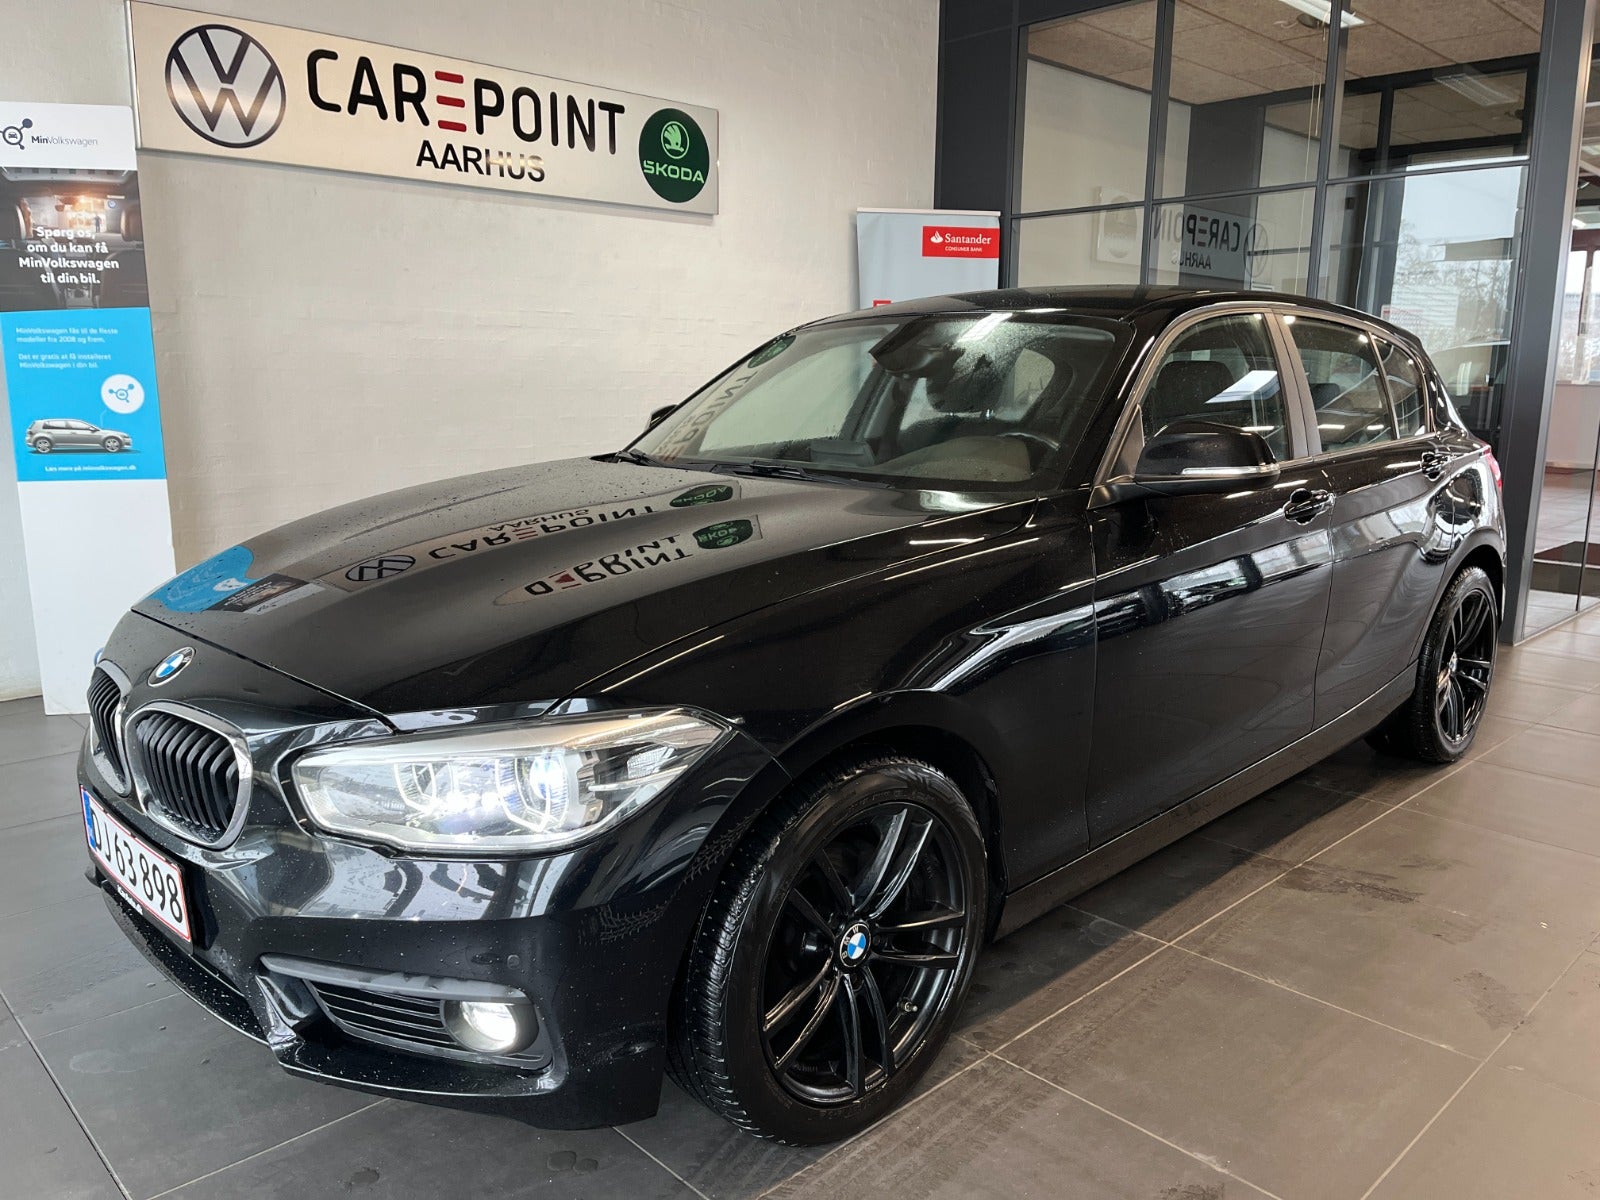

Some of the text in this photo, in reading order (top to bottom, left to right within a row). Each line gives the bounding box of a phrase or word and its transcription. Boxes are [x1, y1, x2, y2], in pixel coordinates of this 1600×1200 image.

[307, 49, 625, 155] CAREPOINT
[31, 135, 98, 147] MinVolkswagen
[416, 140, 545, 182] AARHUS
[36, 226, 96, 240] Spørg os,
[945, 233, 992, 244] Santander
[27, 242, 109, 254] om du kan få
[18, 257, 120, 271] MinVolkswagen
[40, 272, 101, 284] til din bil.
[139, 853, 183, 923] 898
